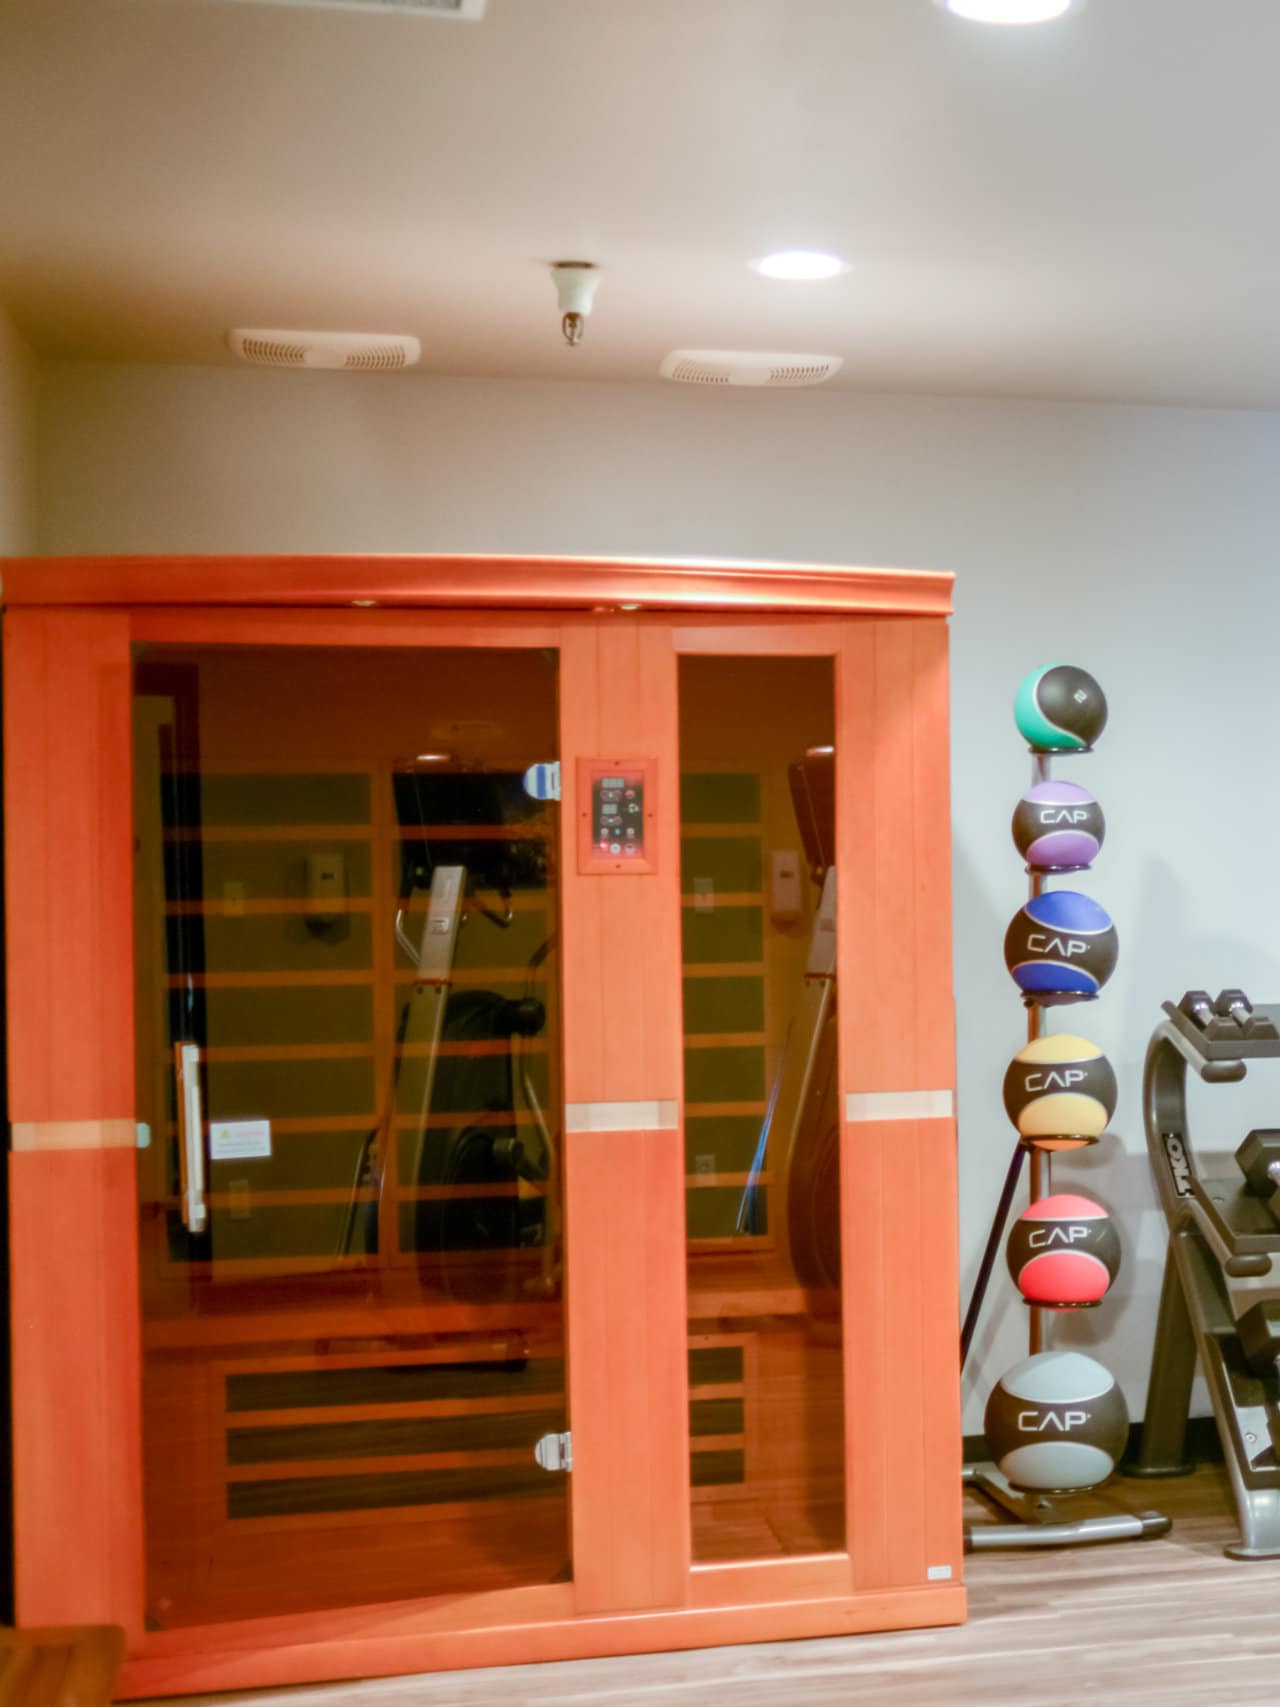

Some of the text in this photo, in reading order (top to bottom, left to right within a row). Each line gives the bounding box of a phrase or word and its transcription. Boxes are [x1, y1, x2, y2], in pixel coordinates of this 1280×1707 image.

[1040, 810, 1088, 824] CAP
[1027, 934, 1089, 957] CAP
[1024, 1070, 1086, 1092] CAP
[1028, 1226, 1089, 1248] CAP
[1018, 1411, 1087, 1431] CAP
